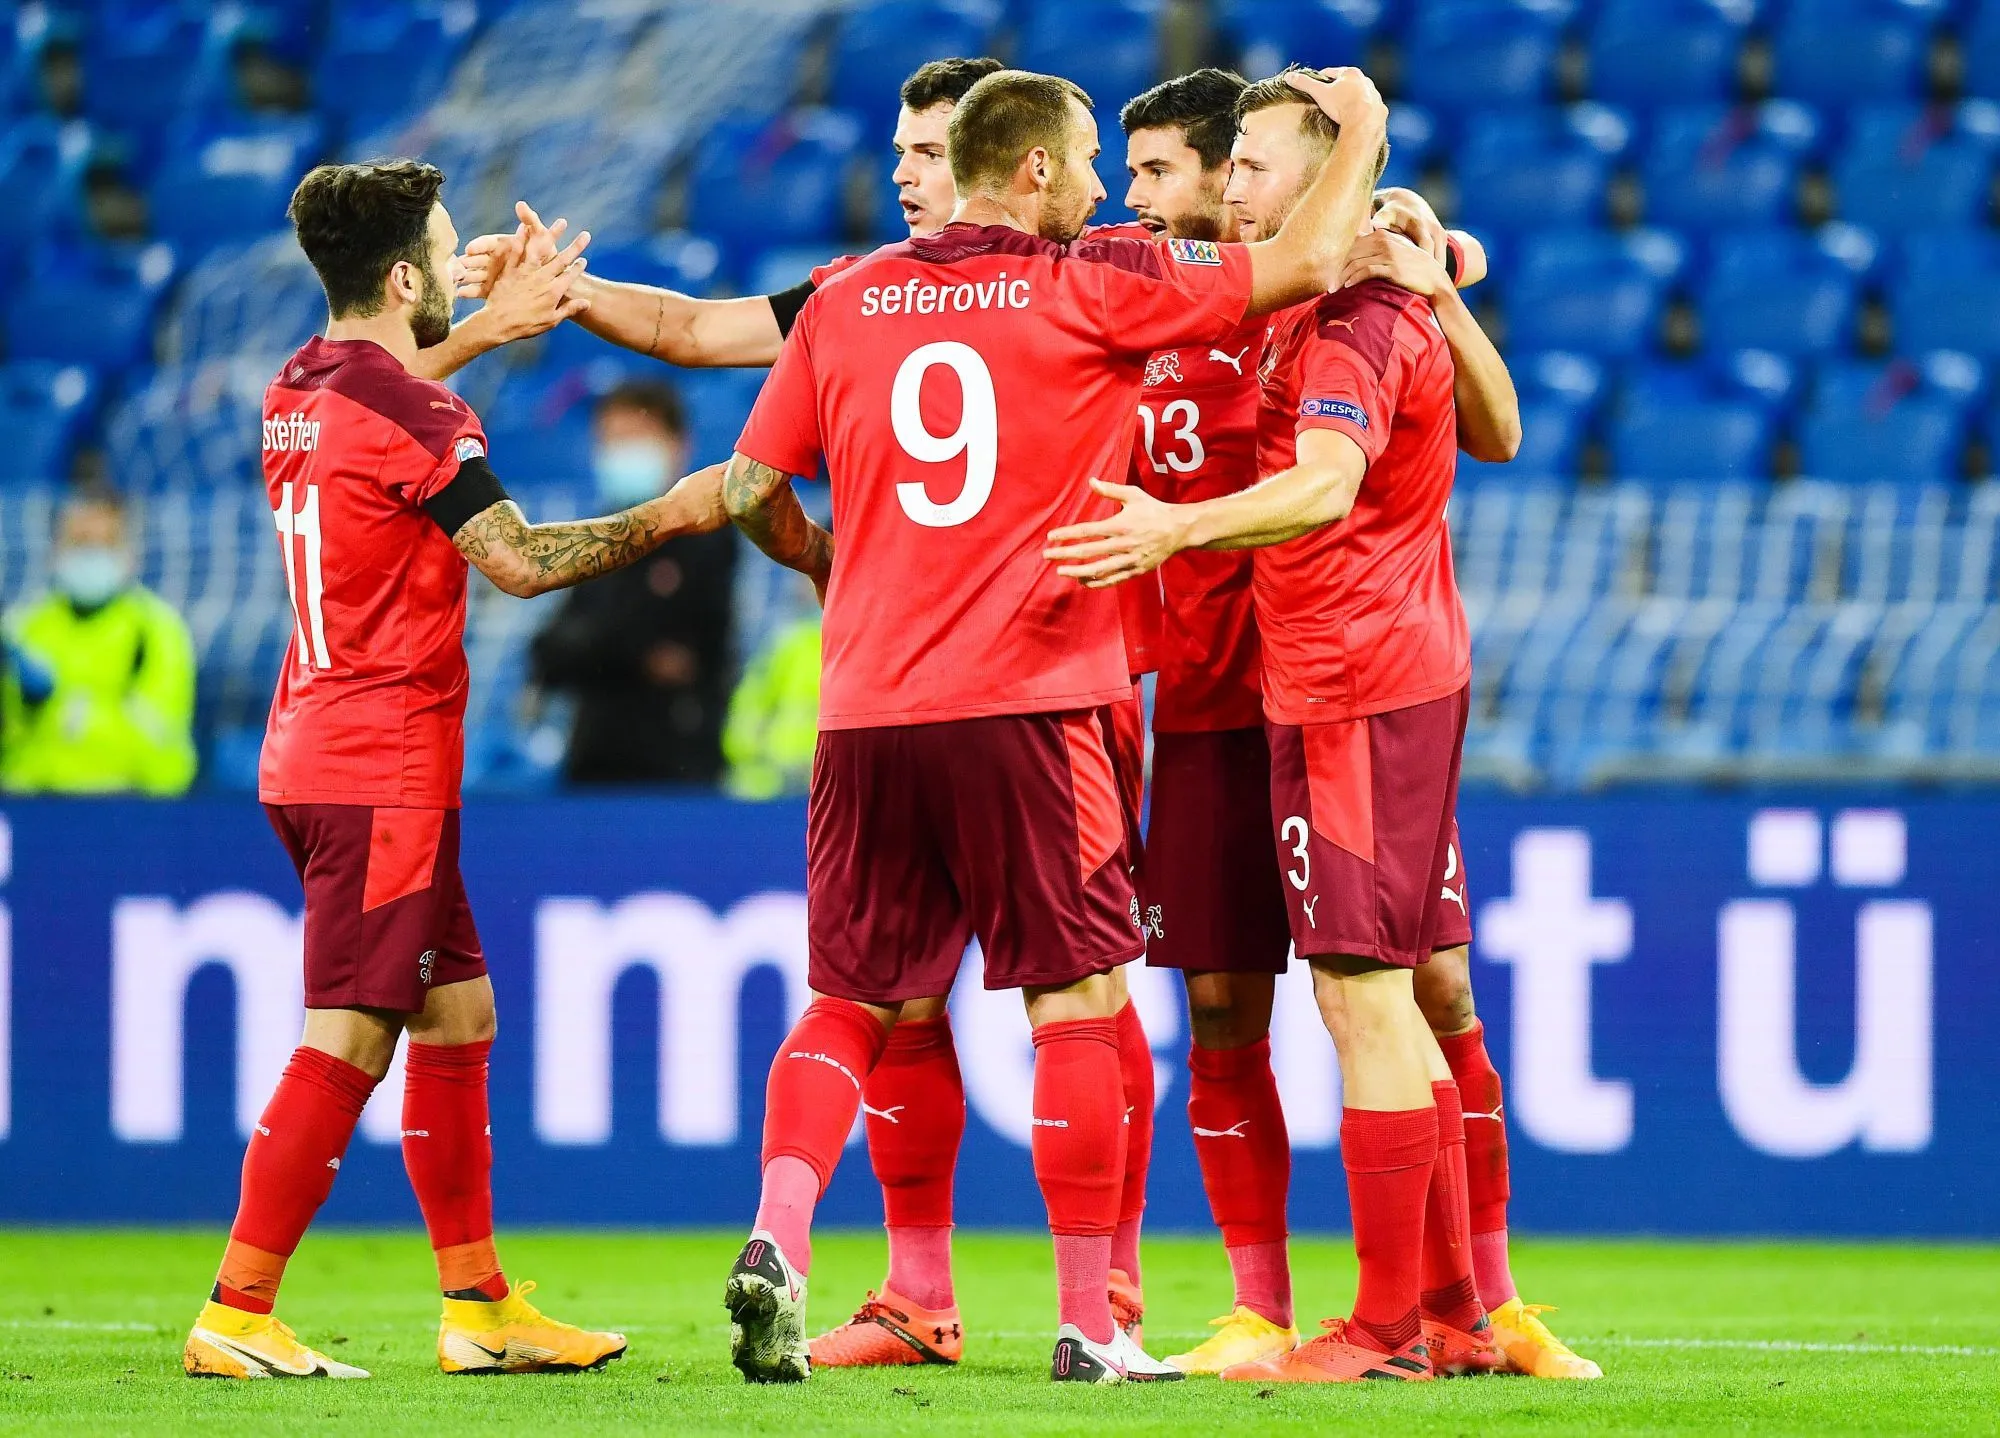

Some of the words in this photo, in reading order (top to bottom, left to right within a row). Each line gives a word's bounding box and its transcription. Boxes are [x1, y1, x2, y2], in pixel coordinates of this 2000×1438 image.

[861, 272, 1031, 317] seferovic
[262, 411, 321, 452] steffen
[889, 340, 998, 527] 9
[1322, 403, 1369, 426] RESPECT
[273, 481, 332, 669] 11
[1281, 816, 1310, 890] 3
